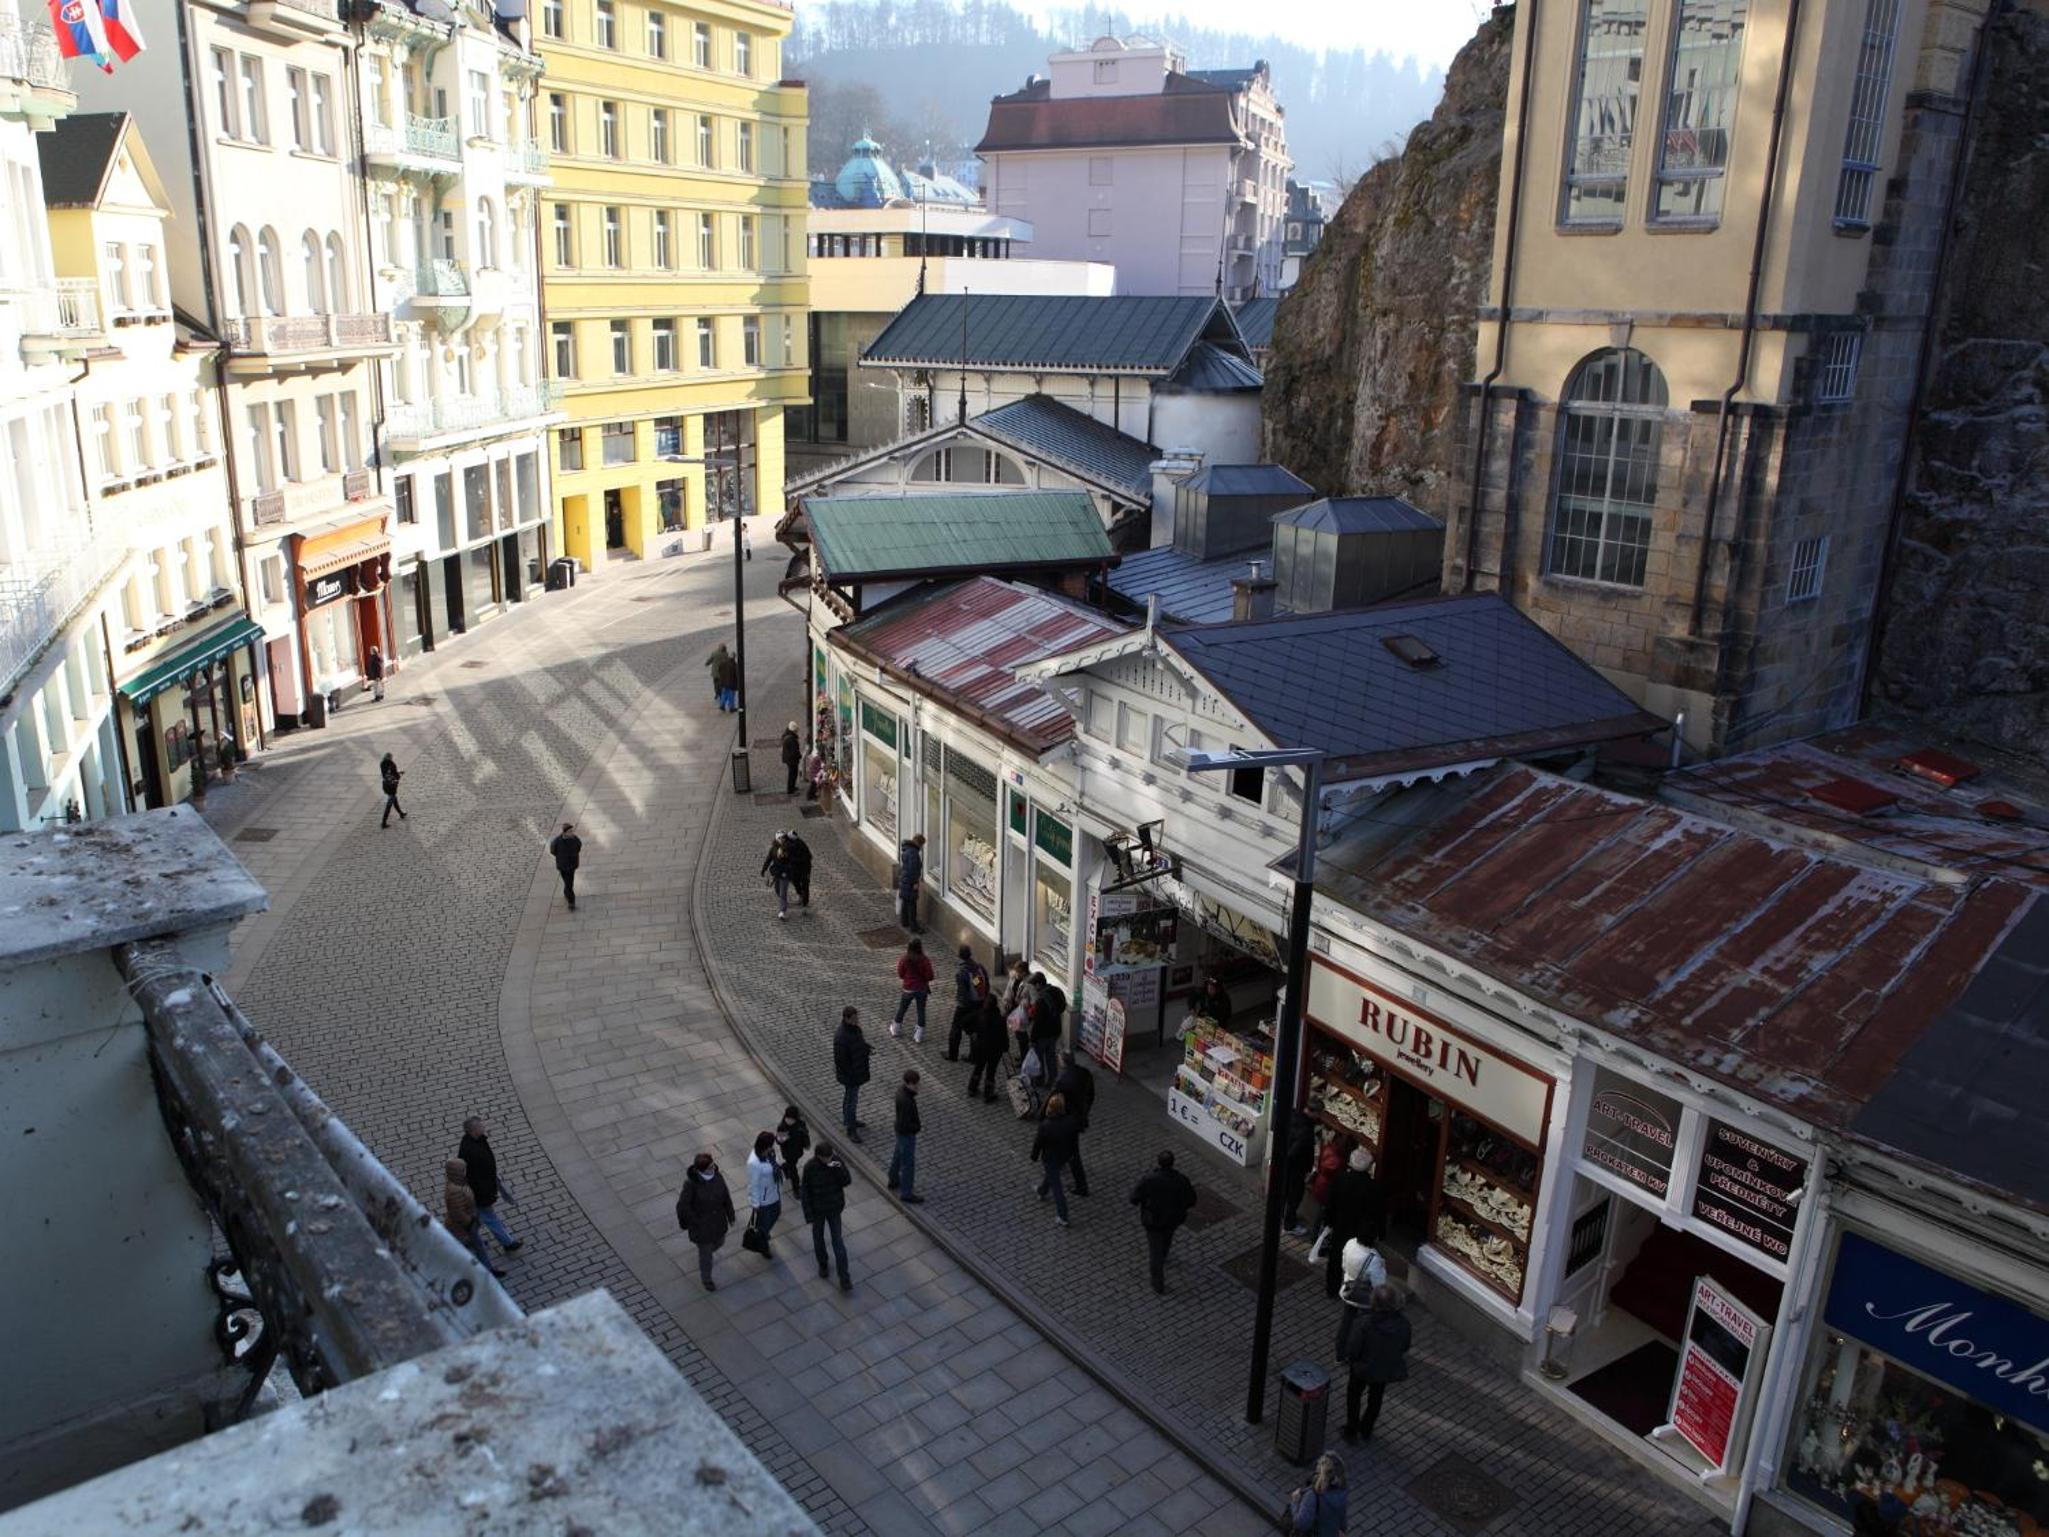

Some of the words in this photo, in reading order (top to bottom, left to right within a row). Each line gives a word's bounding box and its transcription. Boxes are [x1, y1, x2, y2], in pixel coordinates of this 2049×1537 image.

[1358, 996, 1482, 1088] RUBIN
[1396, 1047, 1435, 1077] jewellery
[1169, 1098, 1178, 1114] 1
[1181, 1105, 1188, 1120] €
[1219, 1131, 1245, 1158] CZK
[1718, 1127, 1799, 1172] SUVENÝRY
[1746, 1157, 1760, 1173] &
[1697, 1200, 1763, 1243] VEŘEJNÉ
[1698, 1285, 1754, 1338] ART-TRAVEL
[1864, 1301, 2049, 1400] Monh
